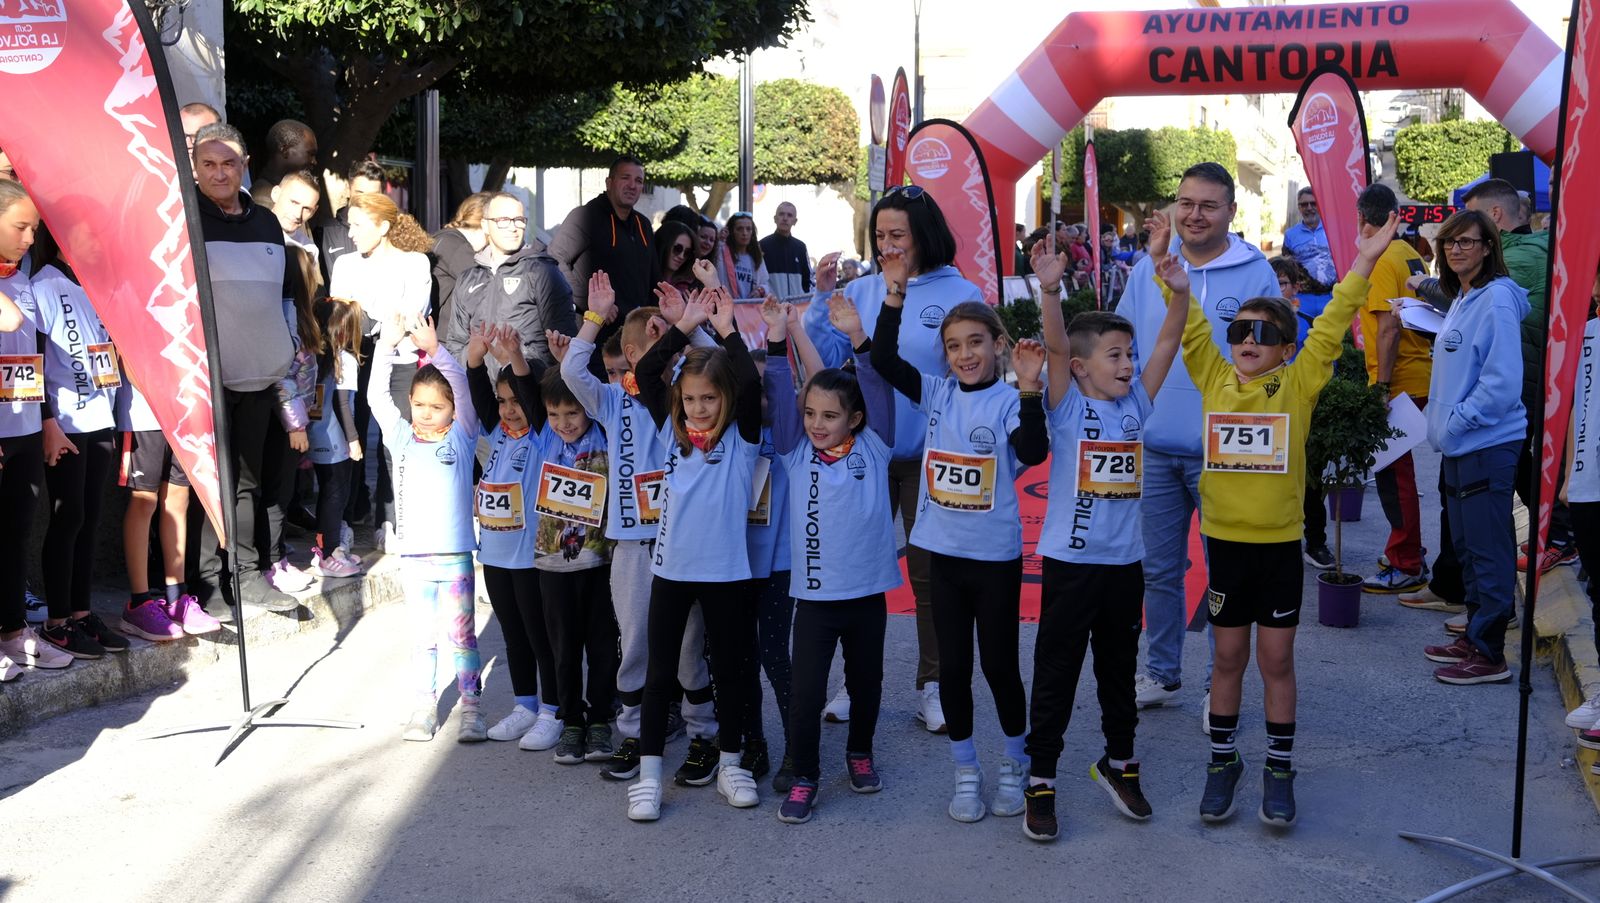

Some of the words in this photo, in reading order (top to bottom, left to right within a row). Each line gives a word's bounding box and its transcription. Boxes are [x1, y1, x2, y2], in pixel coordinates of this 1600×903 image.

[1142, 4, 1410, 34] AYUNTAMIENTO
[1149, 39, 1400, 84] CANTORIA
[59, 294, 73, 314] LA
[2, 365, 35, 381] 742
[65, 319, 90, 411] POLVORILLA
[1220, 427, 1270, 446] 751
[618, 415, 636, 529] POLVORILLA
[934, 463, 981, 486] 750
[1092, 454, 1135, 474] 728
[551, 476, 592, 501] 734
[805, 471, 822, 591] POLVORILLA
